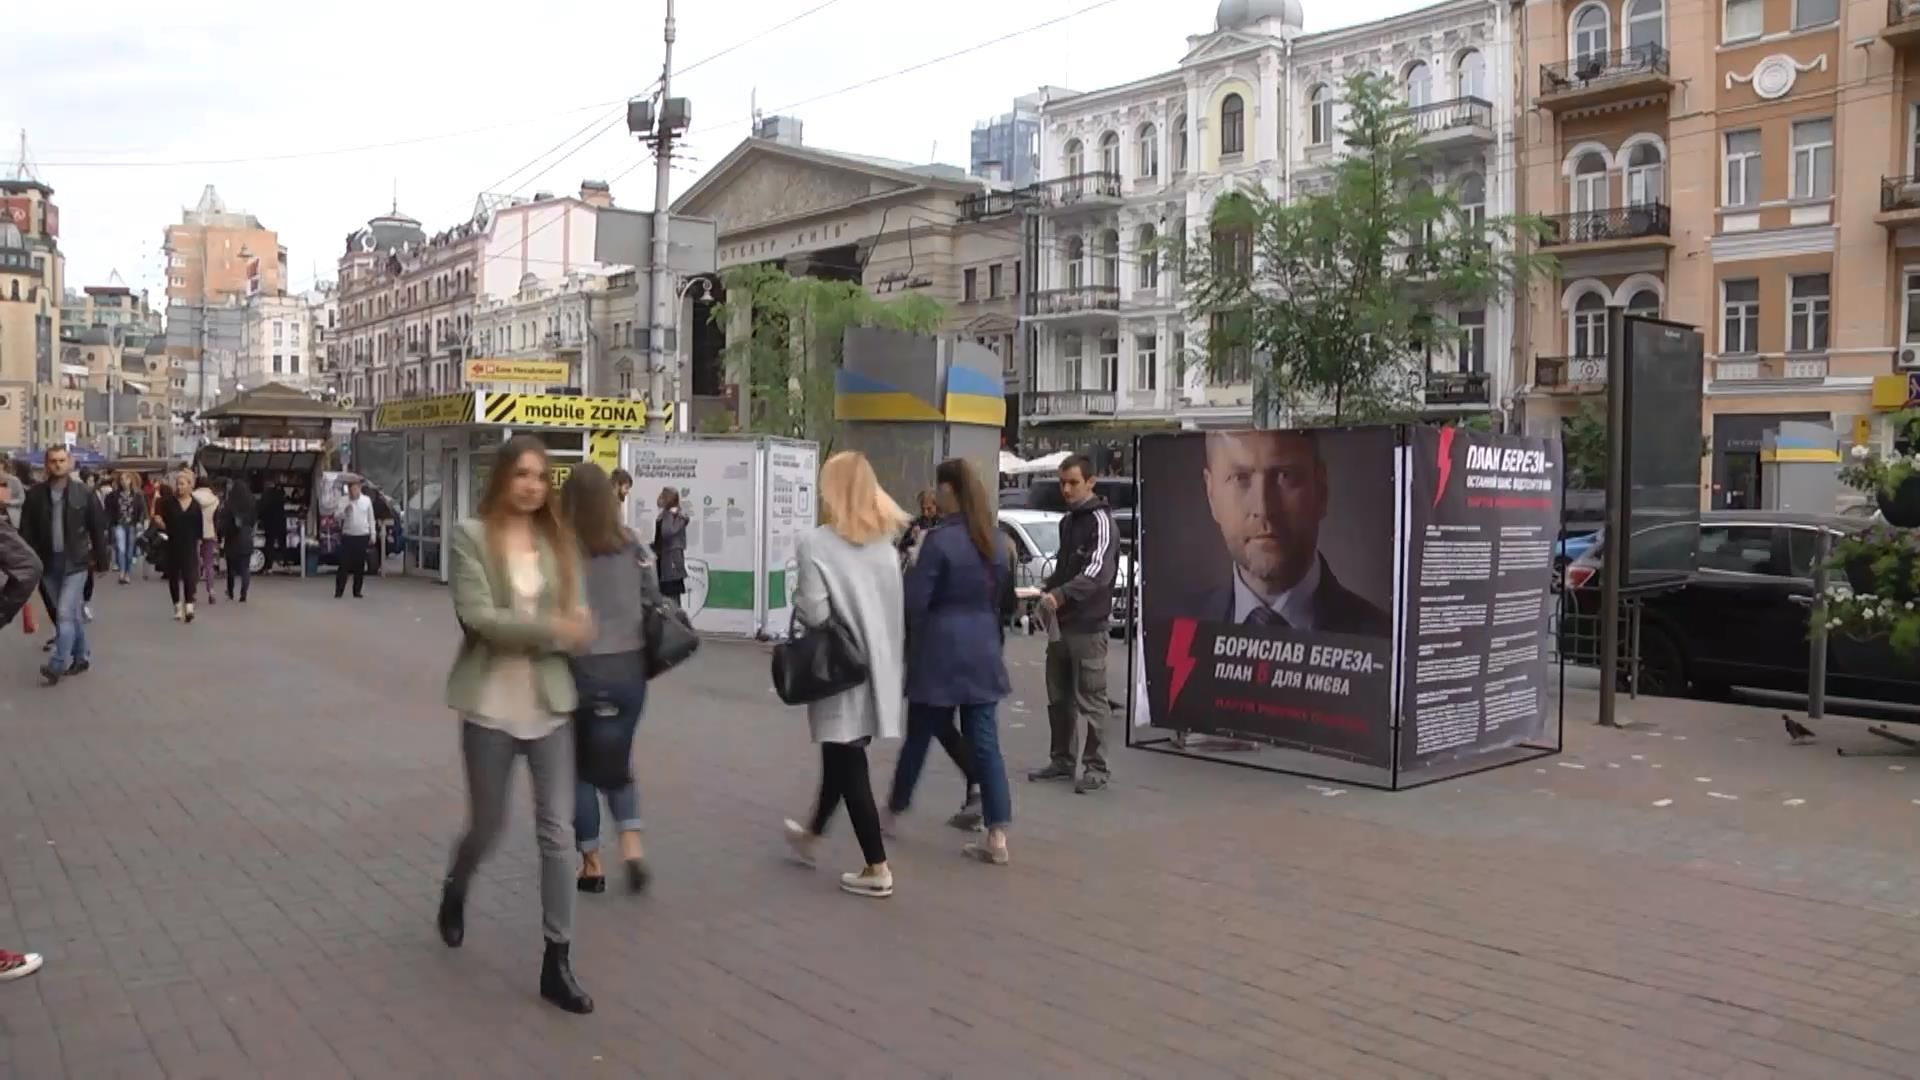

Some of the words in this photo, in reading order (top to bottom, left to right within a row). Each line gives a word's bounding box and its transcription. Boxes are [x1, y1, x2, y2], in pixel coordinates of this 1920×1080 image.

[524, 403, 585, 420] mobile
[590, 405, 638, 423] ZONA
[1466, 444, 1501, 470] ПЛАН
[1214, 635, 1305, 665] БОРИСЛАВ
[1215, 662, 1253, 682] ПЛАН
[1271, 668, 1302, 688] ДЛЯ
[1305, 673, 1350, 696] КИЄВА
